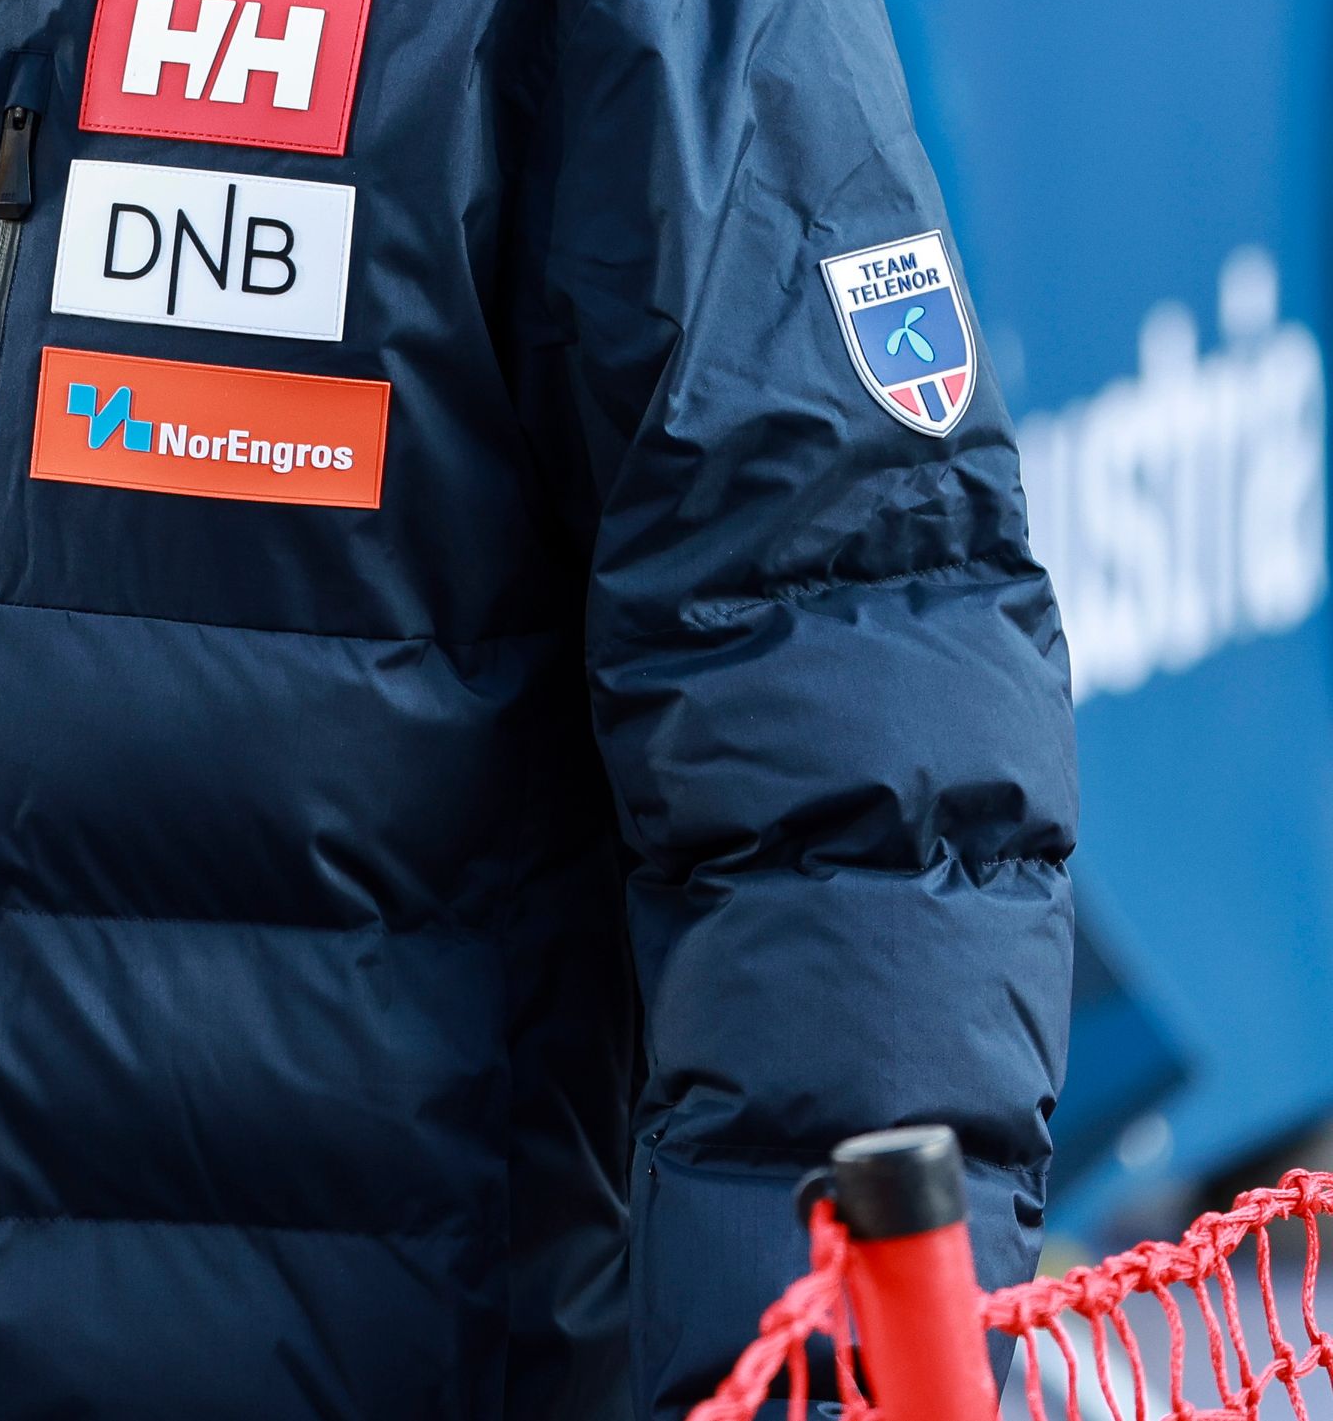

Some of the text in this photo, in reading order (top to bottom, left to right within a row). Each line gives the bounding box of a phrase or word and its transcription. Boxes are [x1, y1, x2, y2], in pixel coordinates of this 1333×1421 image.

[102, 182, 299, 316] DNB
[859, 251, 918, 280] TEAM
[847, 267, 941, 307] TELENOR
[157, 421, 355, 474] NorEngros
